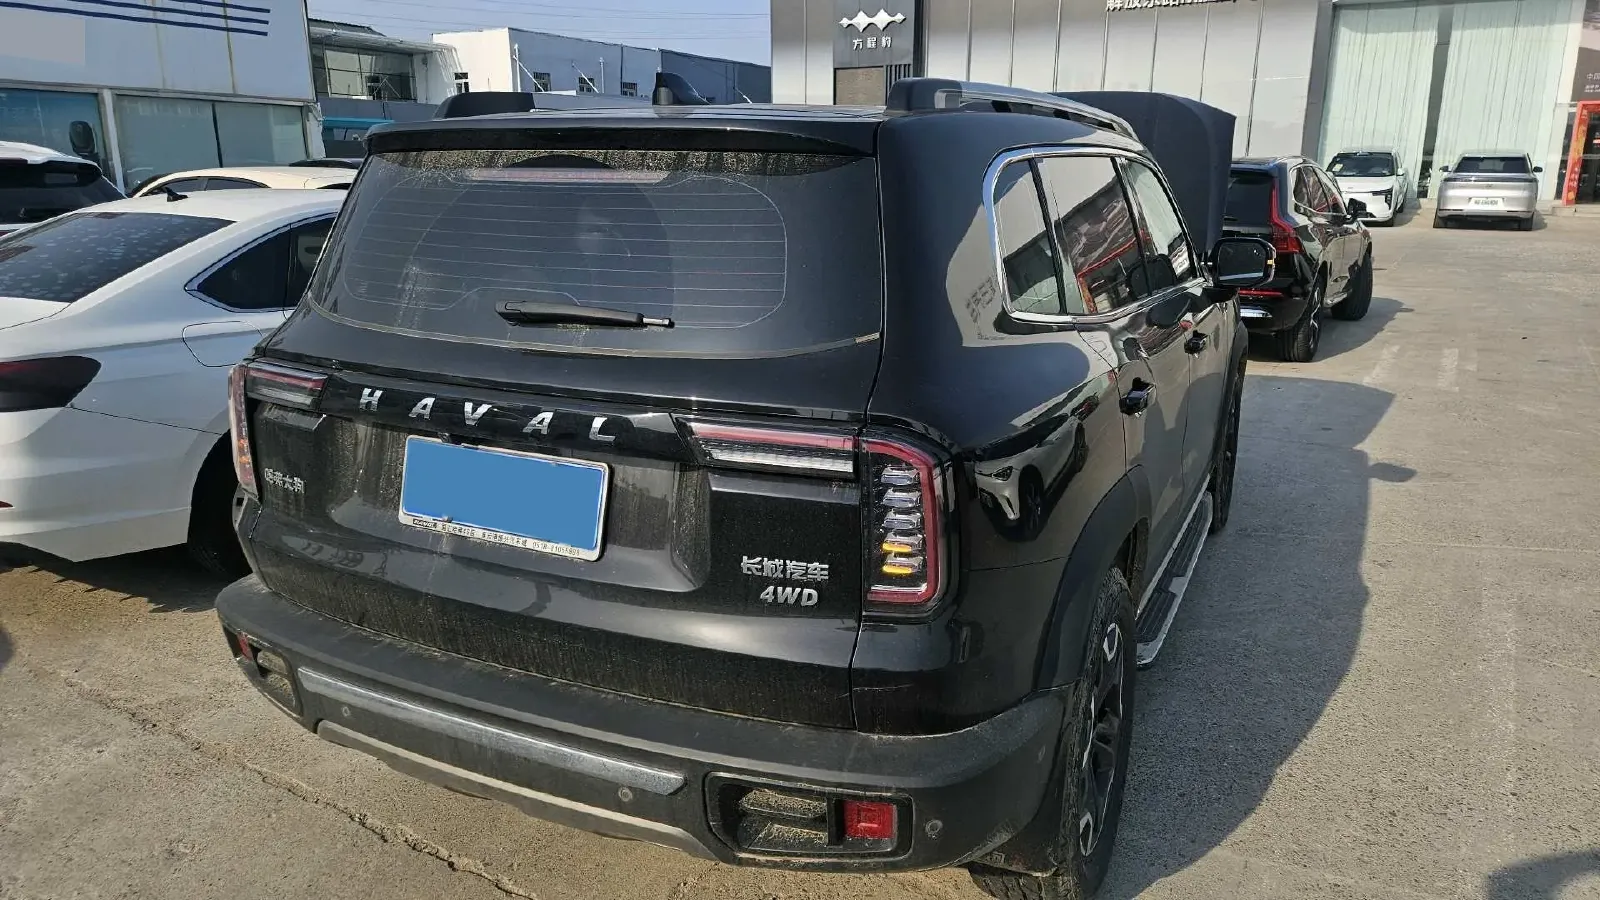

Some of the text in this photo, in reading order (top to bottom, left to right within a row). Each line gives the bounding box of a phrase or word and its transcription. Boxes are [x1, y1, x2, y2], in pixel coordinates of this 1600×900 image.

[853, 36, 892, 51] 方程豹
[359, 388, 616, 442] HAVAL
[740, 555, 830, 581] 长城汽车
[760, 585, 819, 607] 4WD
